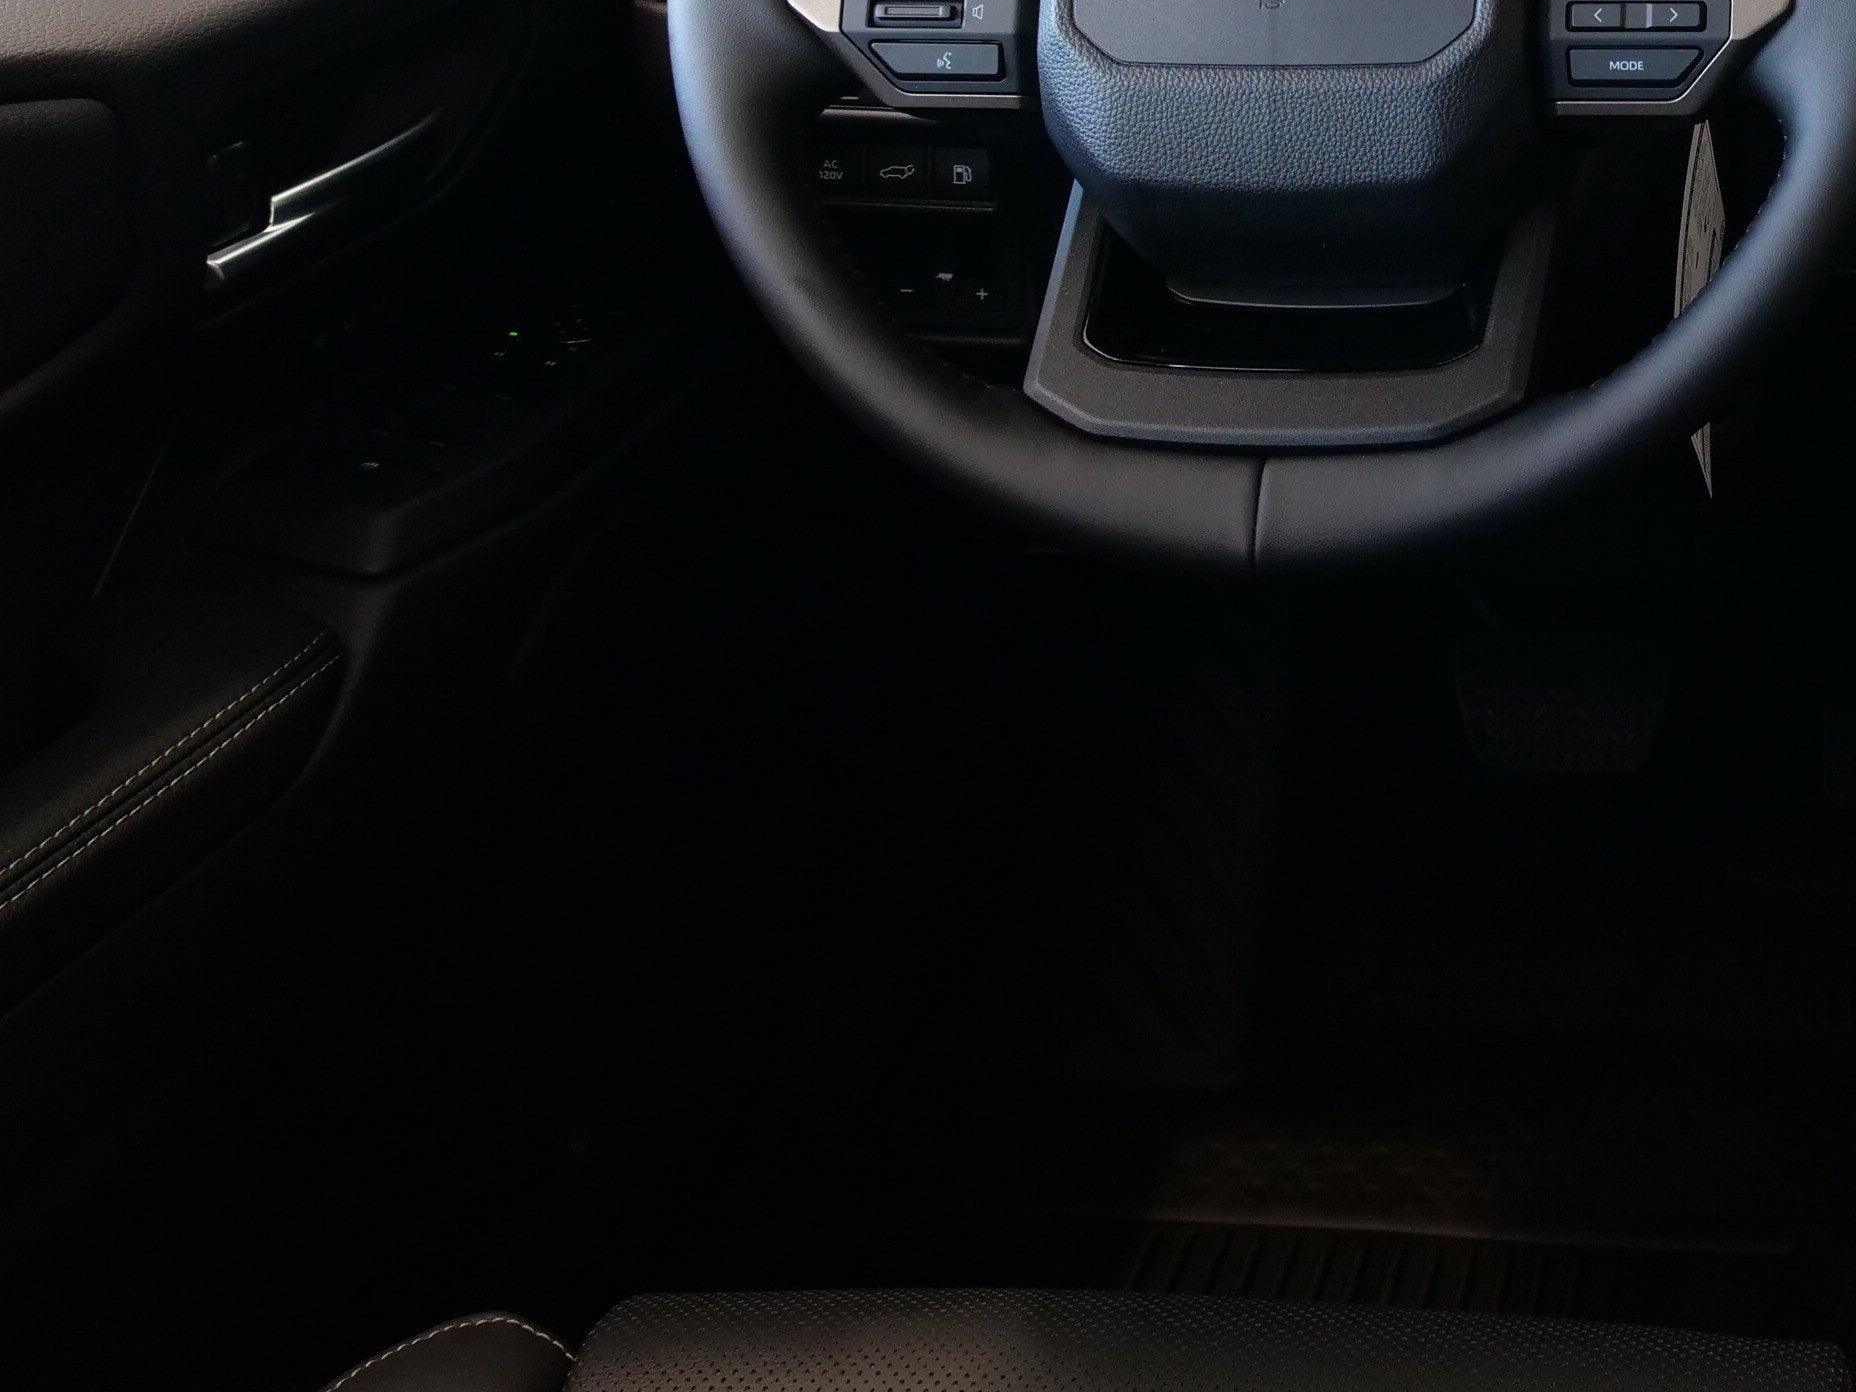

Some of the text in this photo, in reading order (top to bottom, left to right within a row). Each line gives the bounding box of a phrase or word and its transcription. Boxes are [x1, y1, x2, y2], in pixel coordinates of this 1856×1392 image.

[1609, 61, 1644, 71] MODE
[823, 160, 838, 169] AC
[819, 170, 844, 180] 120V
